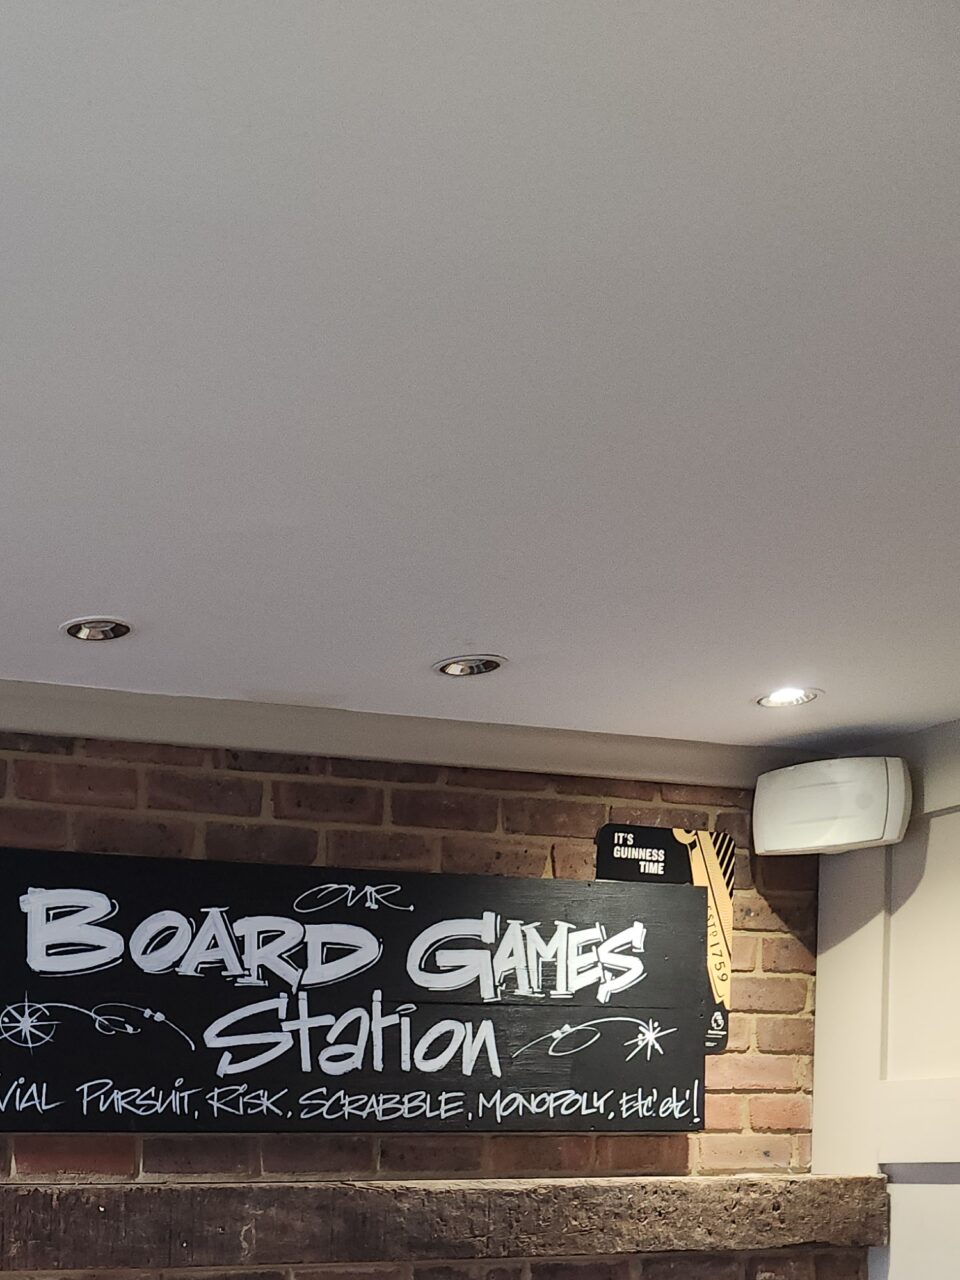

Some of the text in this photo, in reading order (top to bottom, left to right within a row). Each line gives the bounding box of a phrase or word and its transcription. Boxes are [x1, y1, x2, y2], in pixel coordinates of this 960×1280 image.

[613, 846, 665, 862] GUINNESS
[614, 832, 634, 845] IT'S
[639, 861, 665, 875] TIME
[294, 884, 414, 912] OUR
[20, 887, 646, 1003] BOARD GAMES
[710, 942, 729, 982] 1759
[203, 989, 502, 1078] Station
[299, 1087, 473, 1121] SCRABBLE,
[478, 1088, 615, 1123] MONOPOLY,
